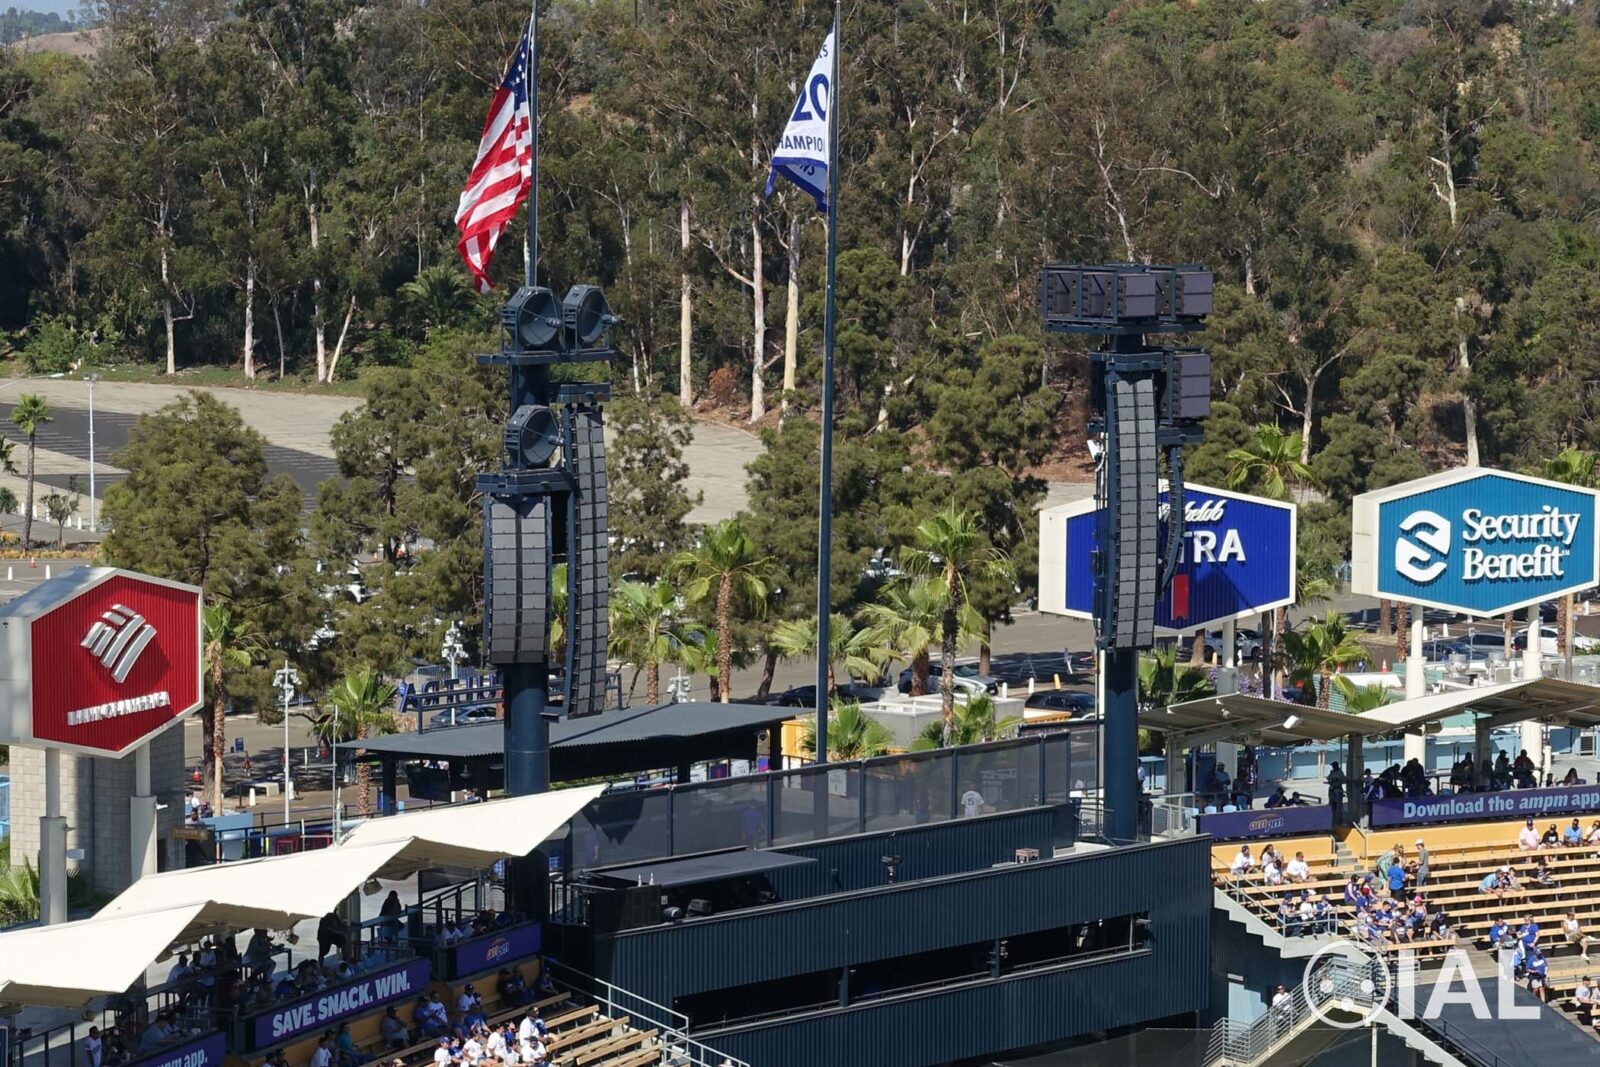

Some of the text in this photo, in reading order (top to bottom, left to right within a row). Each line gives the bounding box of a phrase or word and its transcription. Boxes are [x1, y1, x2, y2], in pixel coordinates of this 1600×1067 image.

[1462, 505, 1581, 545] Security
[1462, 544, 1564, 580] Benefit
[1403, 797, 1484, 818] Download
[1488, 796, 1514, 811] the
[1519, 794, 1568, 811] ampm
[272, 969, 410, 1037] SAVE. SNACK. WIN.
